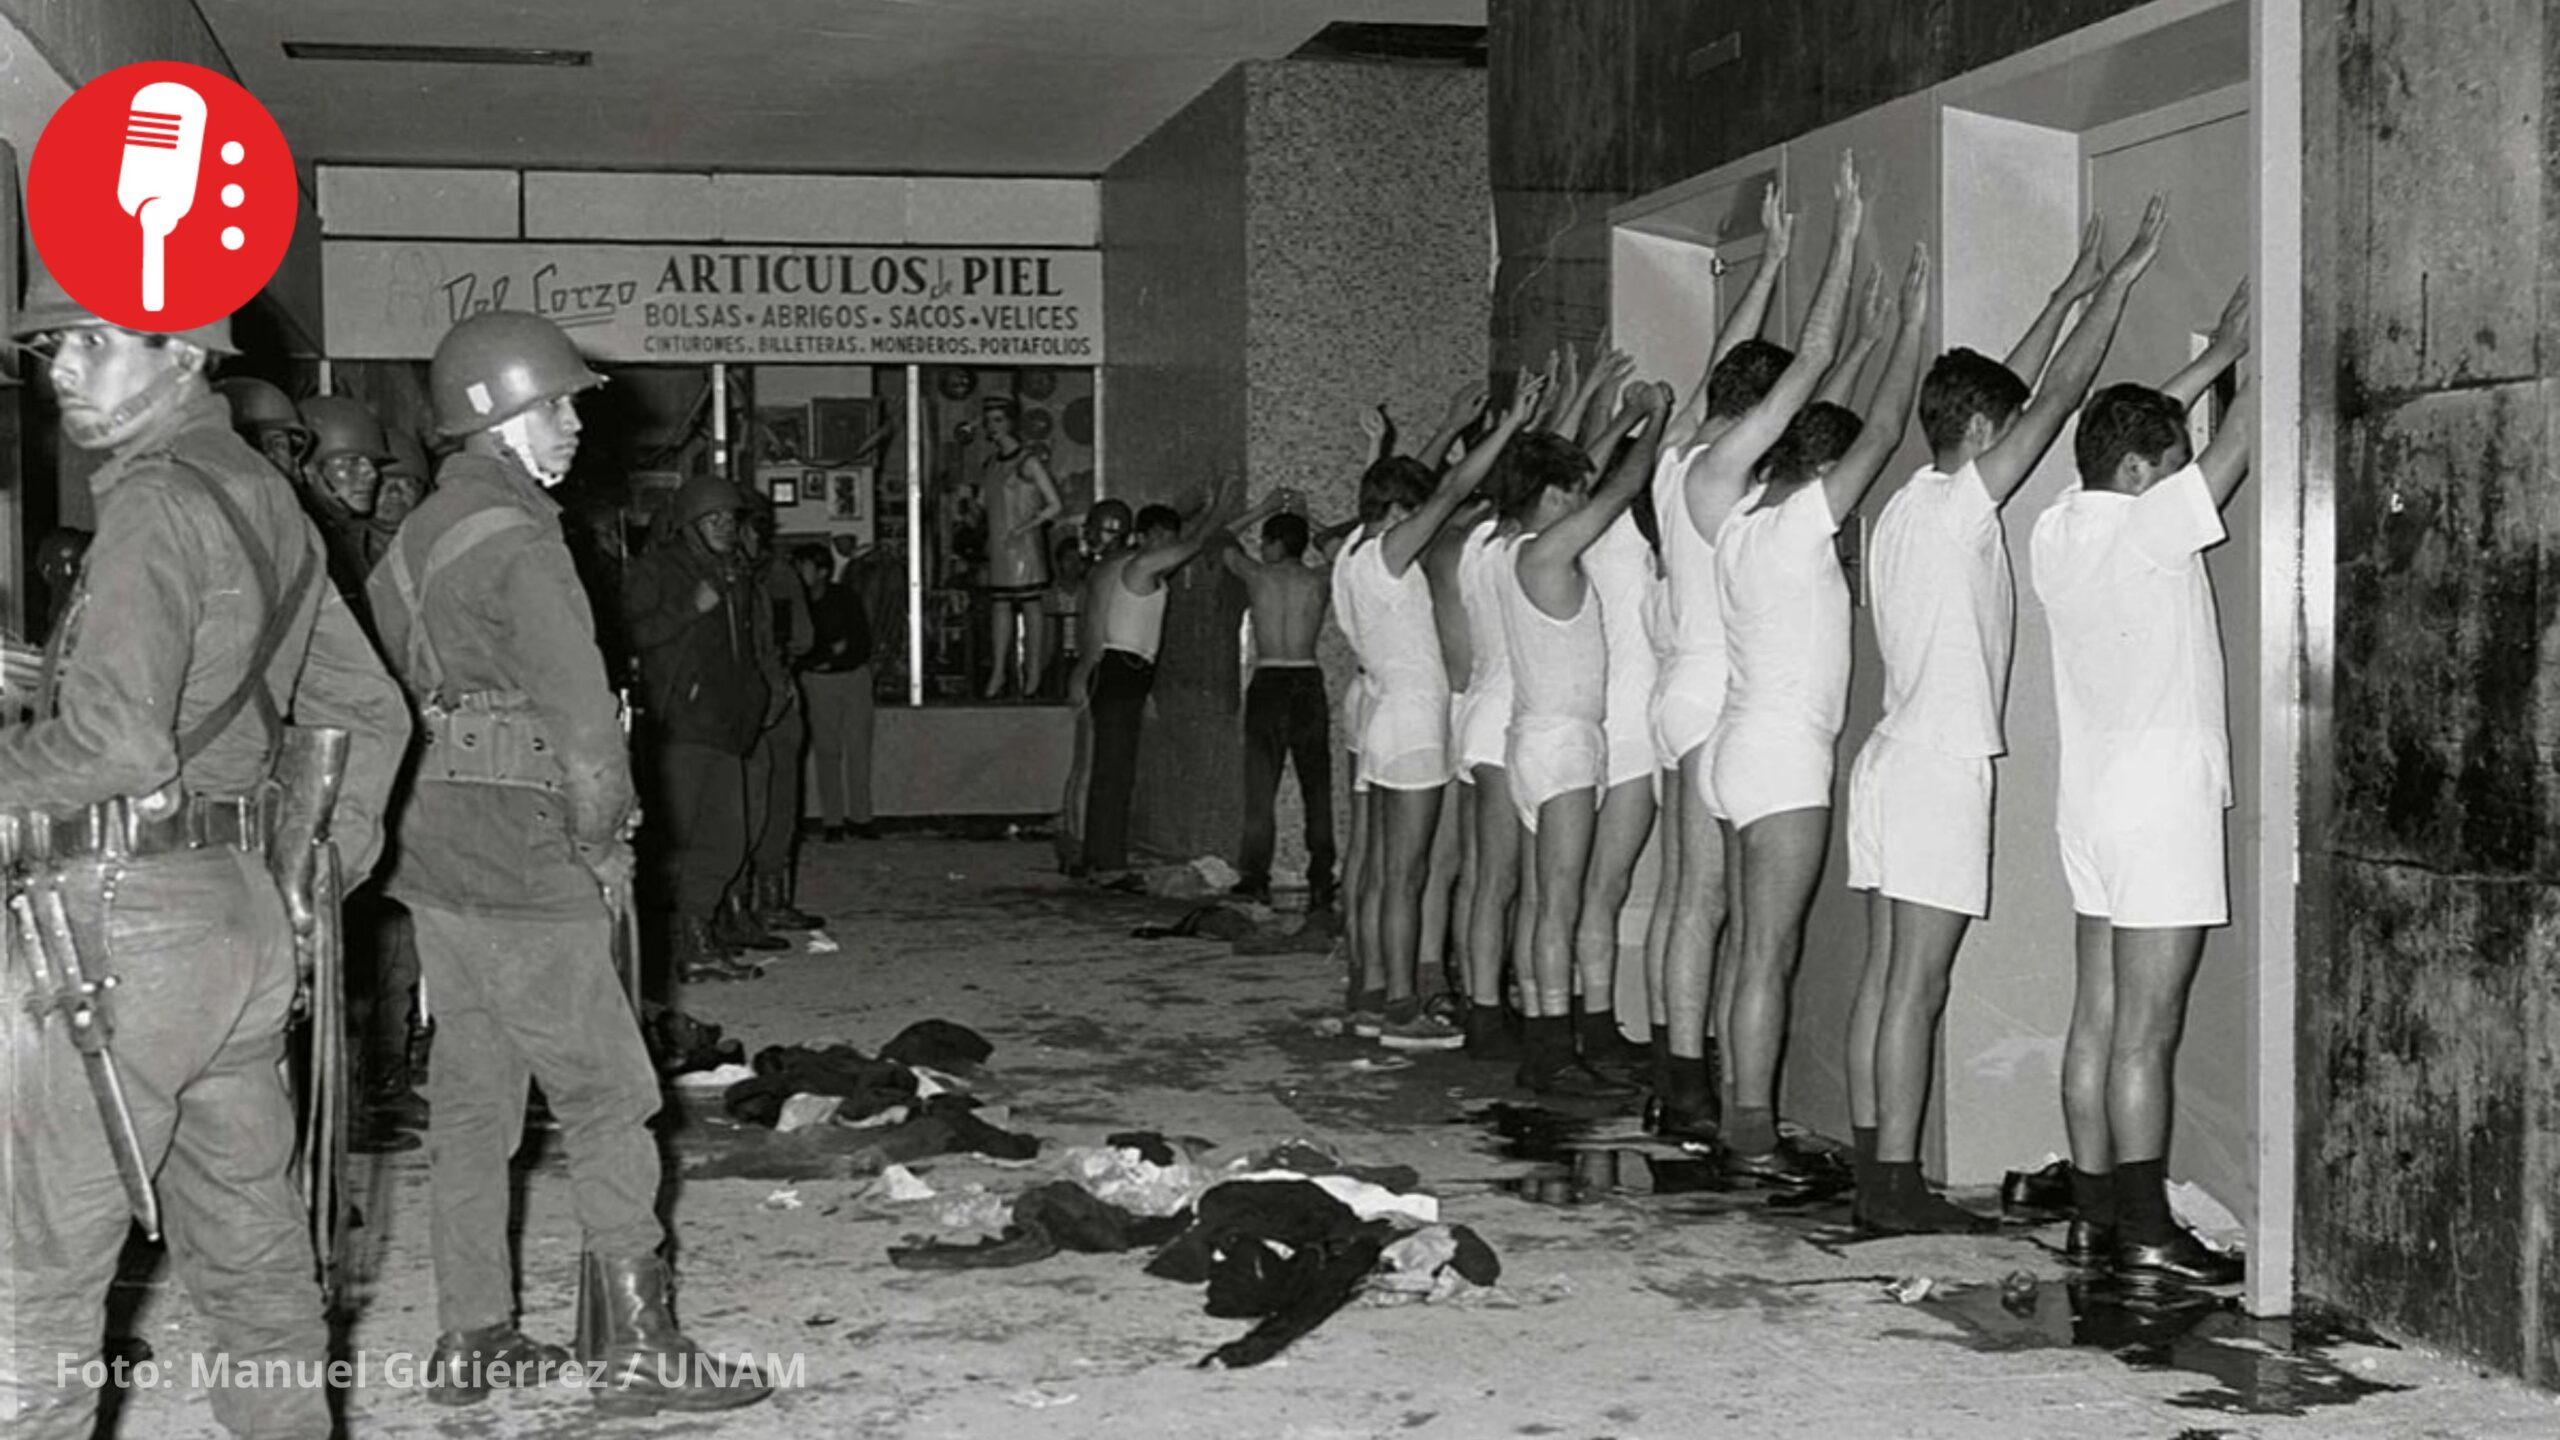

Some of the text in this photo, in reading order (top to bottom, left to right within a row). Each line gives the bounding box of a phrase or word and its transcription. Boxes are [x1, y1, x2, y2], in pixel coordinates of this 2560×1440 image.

[533, 263, 638, 313] Corzo
[656, 254, 927, 294] ARTICULOS
[963, 256, 1063, 296] PIEL
[645, 303, 1078, 330] BOLSAS ABRIGOS SACOS VELICES
[979, 337, 1091, 355] PORTAFOLIOS
